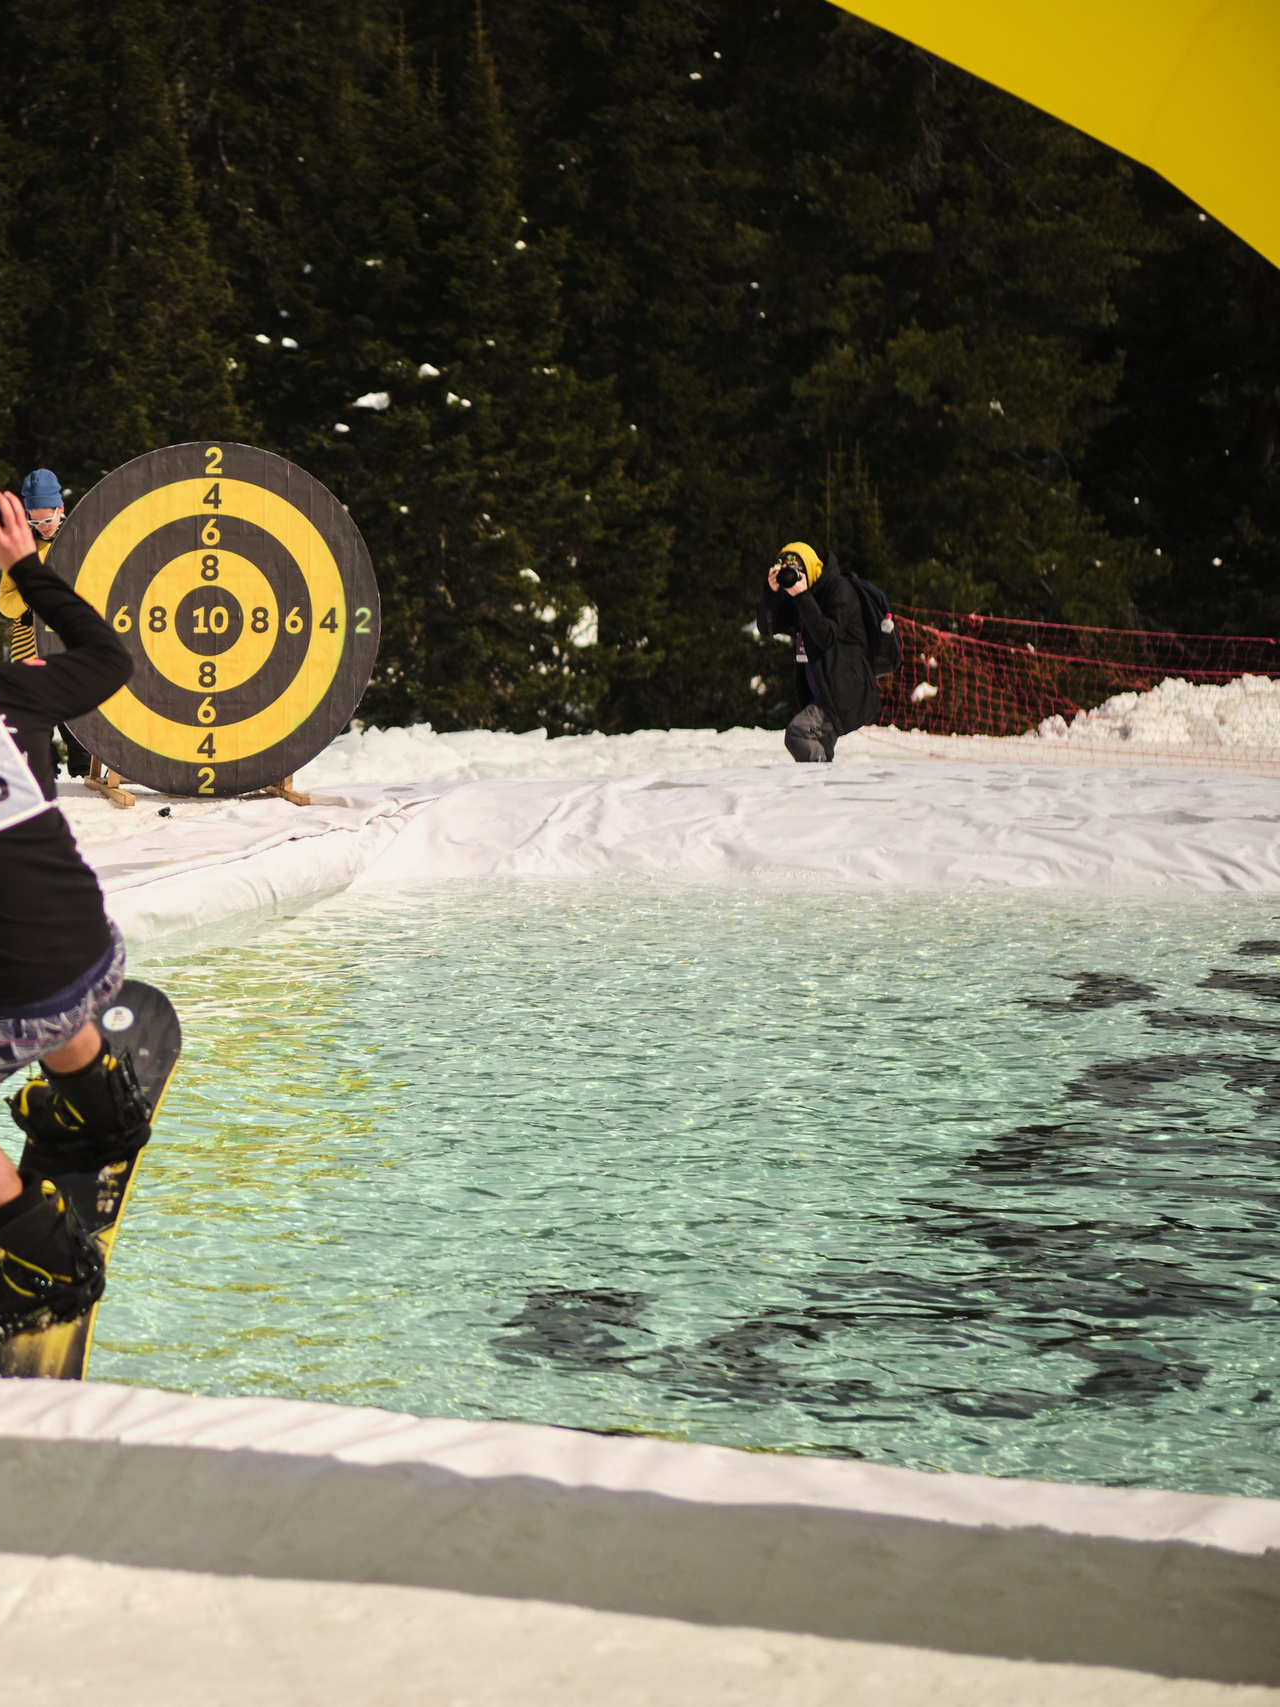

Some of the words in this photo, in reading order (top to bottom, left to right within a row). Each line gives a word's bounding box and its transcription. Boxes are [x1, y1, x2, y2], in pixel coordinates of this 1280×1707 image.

[205, 447, 223, 474] 2
[203, 483, 222, 509] 4
[201, 519, 220, 546] 6
[201, 555, 219, 581] 8
[113, 605, 132, 633] 6
[149, 606, 167, 632] 8
[192, 607, 229, 634] 10
[251, 607, 269, 633] 8
[285, 607, 303, 634] 6
[319, 608, 338, 633] 4
[355, 608, 371, 633] 2
[198, 662, 217, 688] 8
[197, 697, 216, 724] 6
[197, 734, 216, 758] 4
[197, 767, 216, 794] 2
